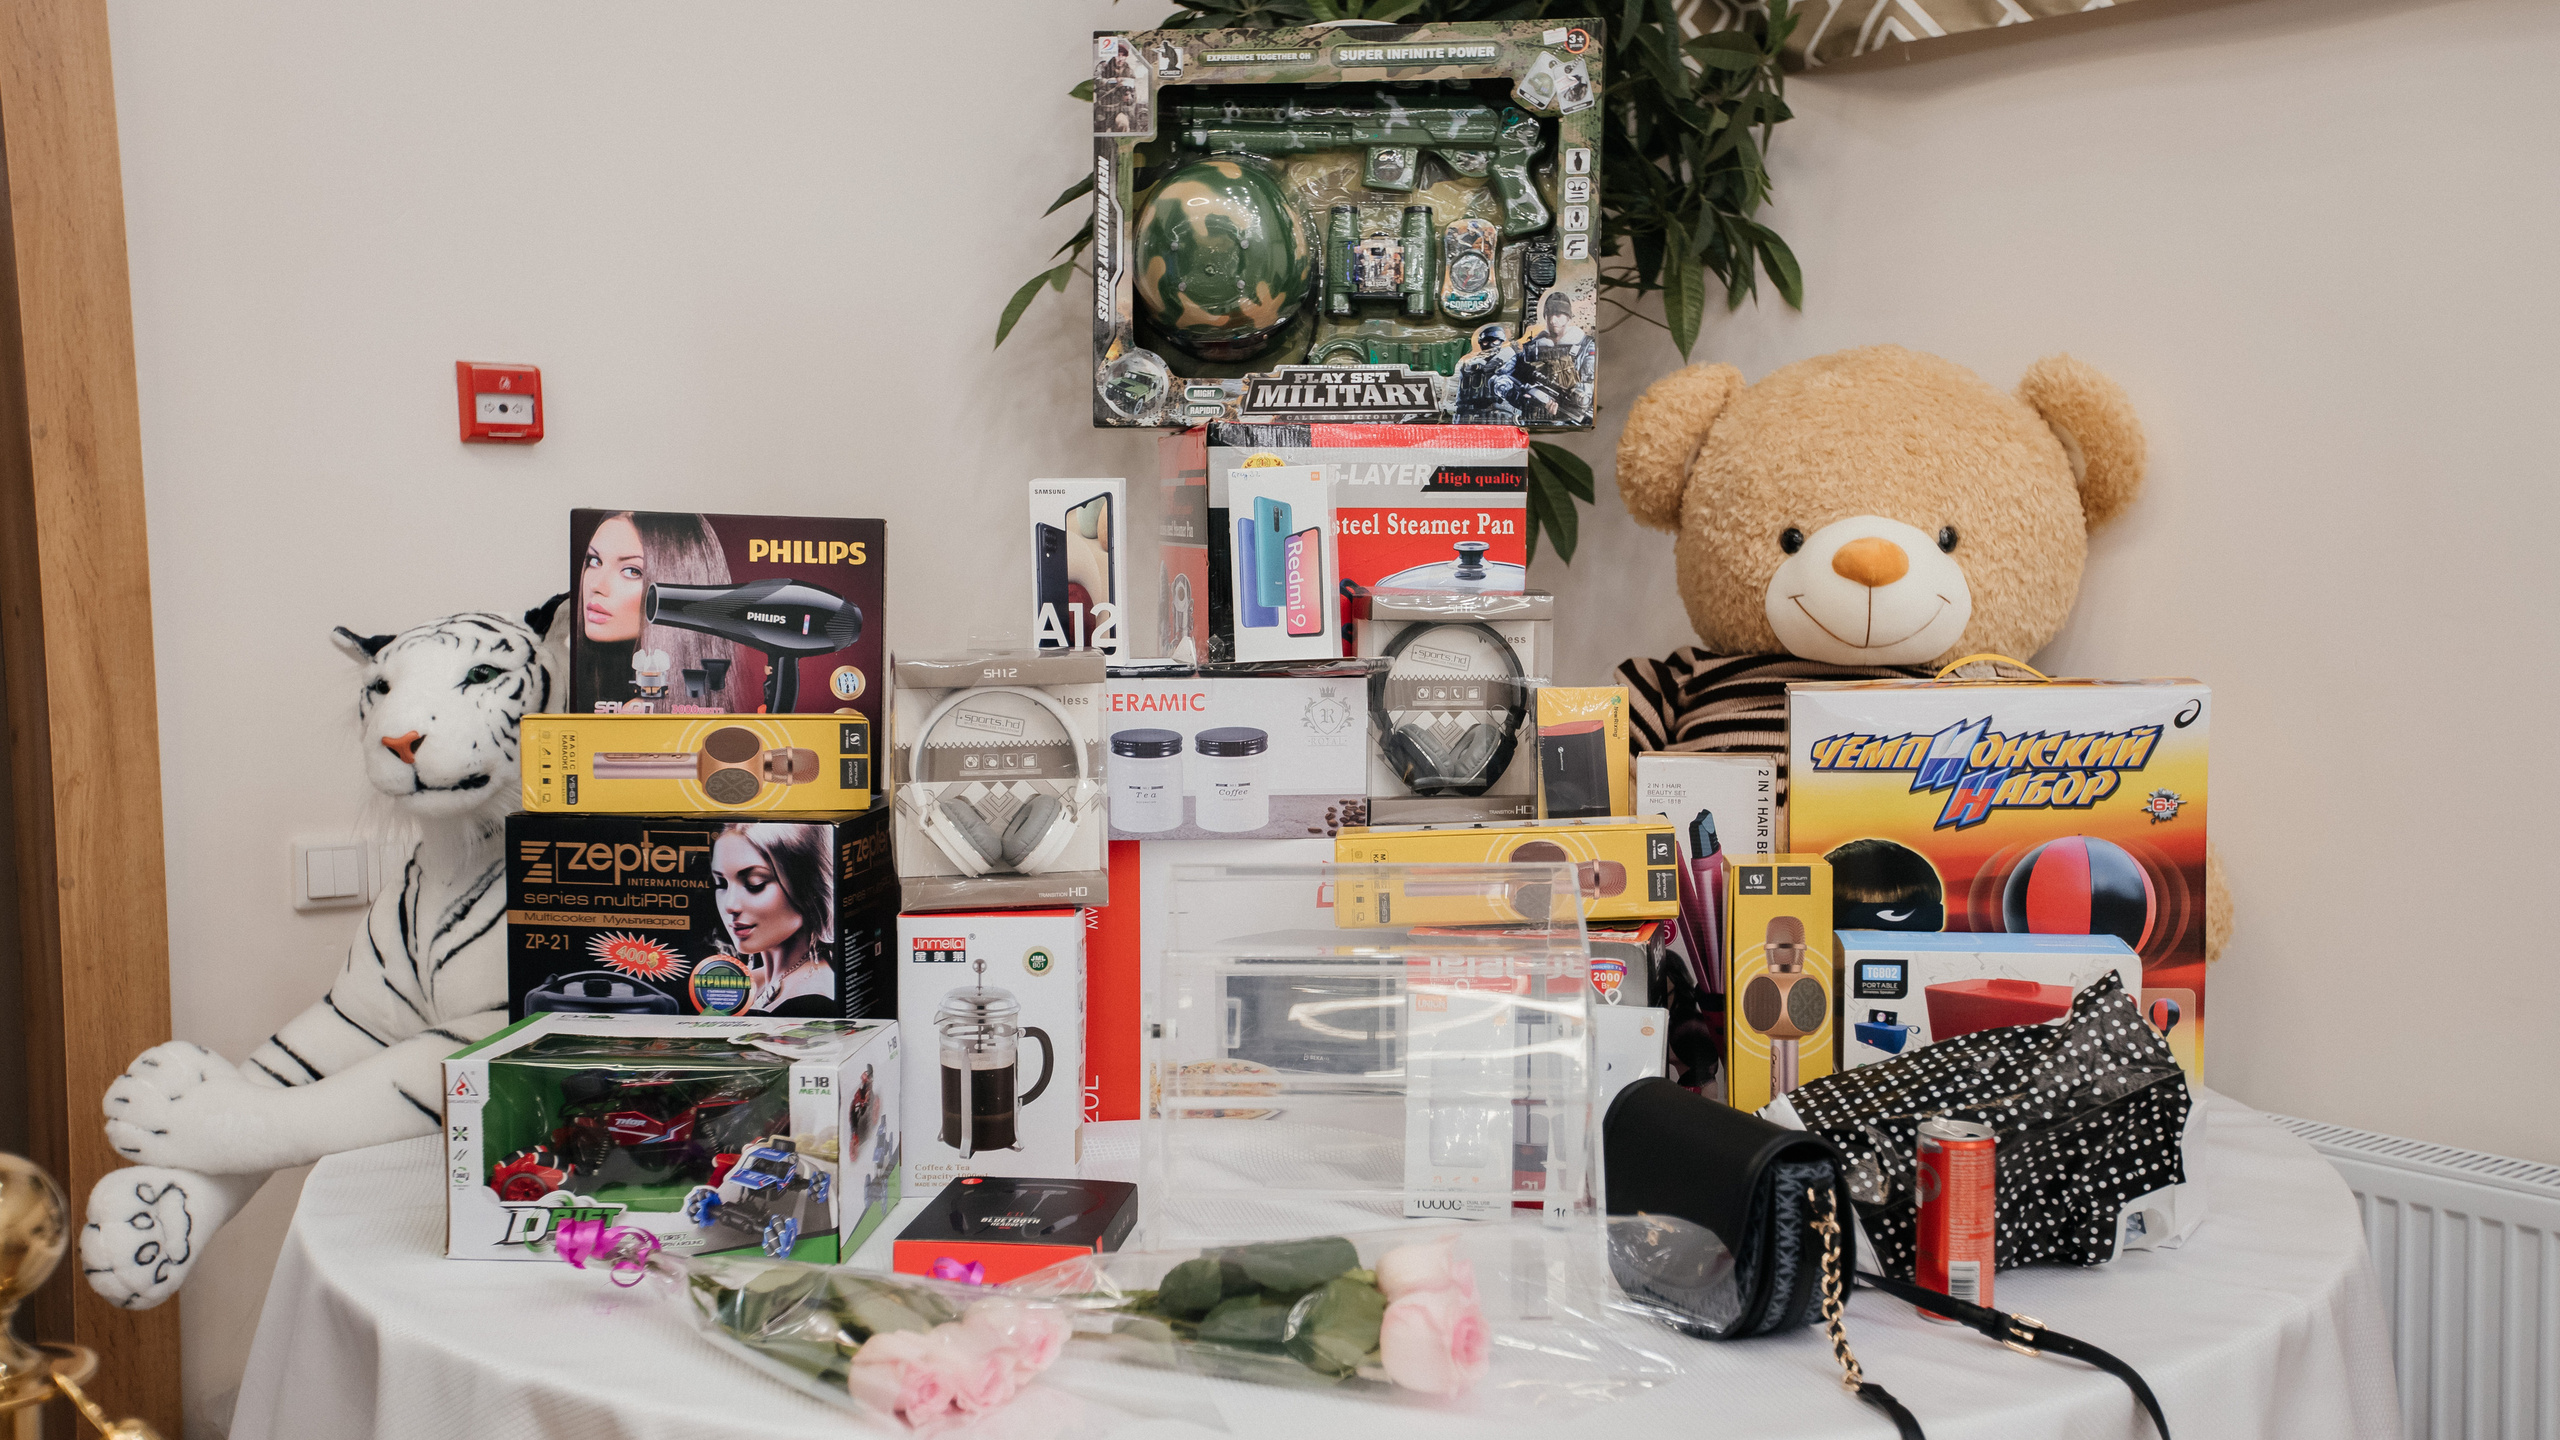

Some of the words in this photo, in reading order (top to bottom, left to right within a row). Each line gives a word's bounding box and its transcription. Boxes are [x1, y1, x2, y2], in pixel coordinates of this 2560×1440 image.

[1568, 34, 1585, 44] 3+
[1206, 53, 1254, 62] EXPERIENCE
[1256, 52, 1298, 61] TOGETHER
[1339, 49, 1384, 60] SUPER
[1387, 47, 1444, 59] INFINITE
[1447, 46, 1495, 58] POWER
[1098, 155, 1109, 194] NEW
[1098, 193, 1109, 267] MILITARY
[1098, 266, 1109, 322] SERIES
[1294, 373, 1345, 384] PLAY
[1350, 372, 1390, 383] SET
[1193, 389, 1216, 398] MIGHT
[1253, 383, 1429, 408] MILITARY
[1189, 405, 1221, 415] RAPIDITY
[1437, 472, 1471, 487] High
[1475, 472, 1523, 487] quality
[1387, 512, 1470, 535] Steamer
[1477, 513, 1514, 535] Pan
[749, 538, 867, 566] PHILIPS
[1288, 541, 1304, 610] Redmi
[746, 611, 787, 625] PHILIPS
[1291, 613, 1306, 628] 9
[1037, 602, 1117, 651] A12
[983, 668, 1018, 679] SH12
[964, 713, 1021, 730] sports.hd
[1311, 737, 1344, 745] ROYAL
[1811, 715, 2165, 793] ЧЕМПИОНСКИЙ
[1218, 788, 1249, 797] Coffee
[1757, 781, 1769, 792] IN
[1933, 765, 2122, 831] НАБОР
[2152, 797, 2178, 812] 6+
[1515, 805, 1534, 815] HD
[1756, 807, 1769, 837] HAIR
[556, 830, 710, 886] zepter
[627, 878, 710, 889] INTERNATIONAL
[1068, 886, 1088, 897] HD
[524, 891, 589, 905] series
[594, 892, 689, 909] multiPRO
[524, 911, 596, 924] Multicooker
[603, 915, 686, 927] Мультиварка
[525, 933, 569, 950] ZP-21
[913, 938, 965, 951] Jinmeilai
[616, 945, 660, 969] 400$
[1593, 972, 1621, 982] 2000
[1867, 967, 1898, 979] TG802
[693, 974, 752, 989] КЕРАМИКА
[800, 1076, 830, 1088] 1-18
